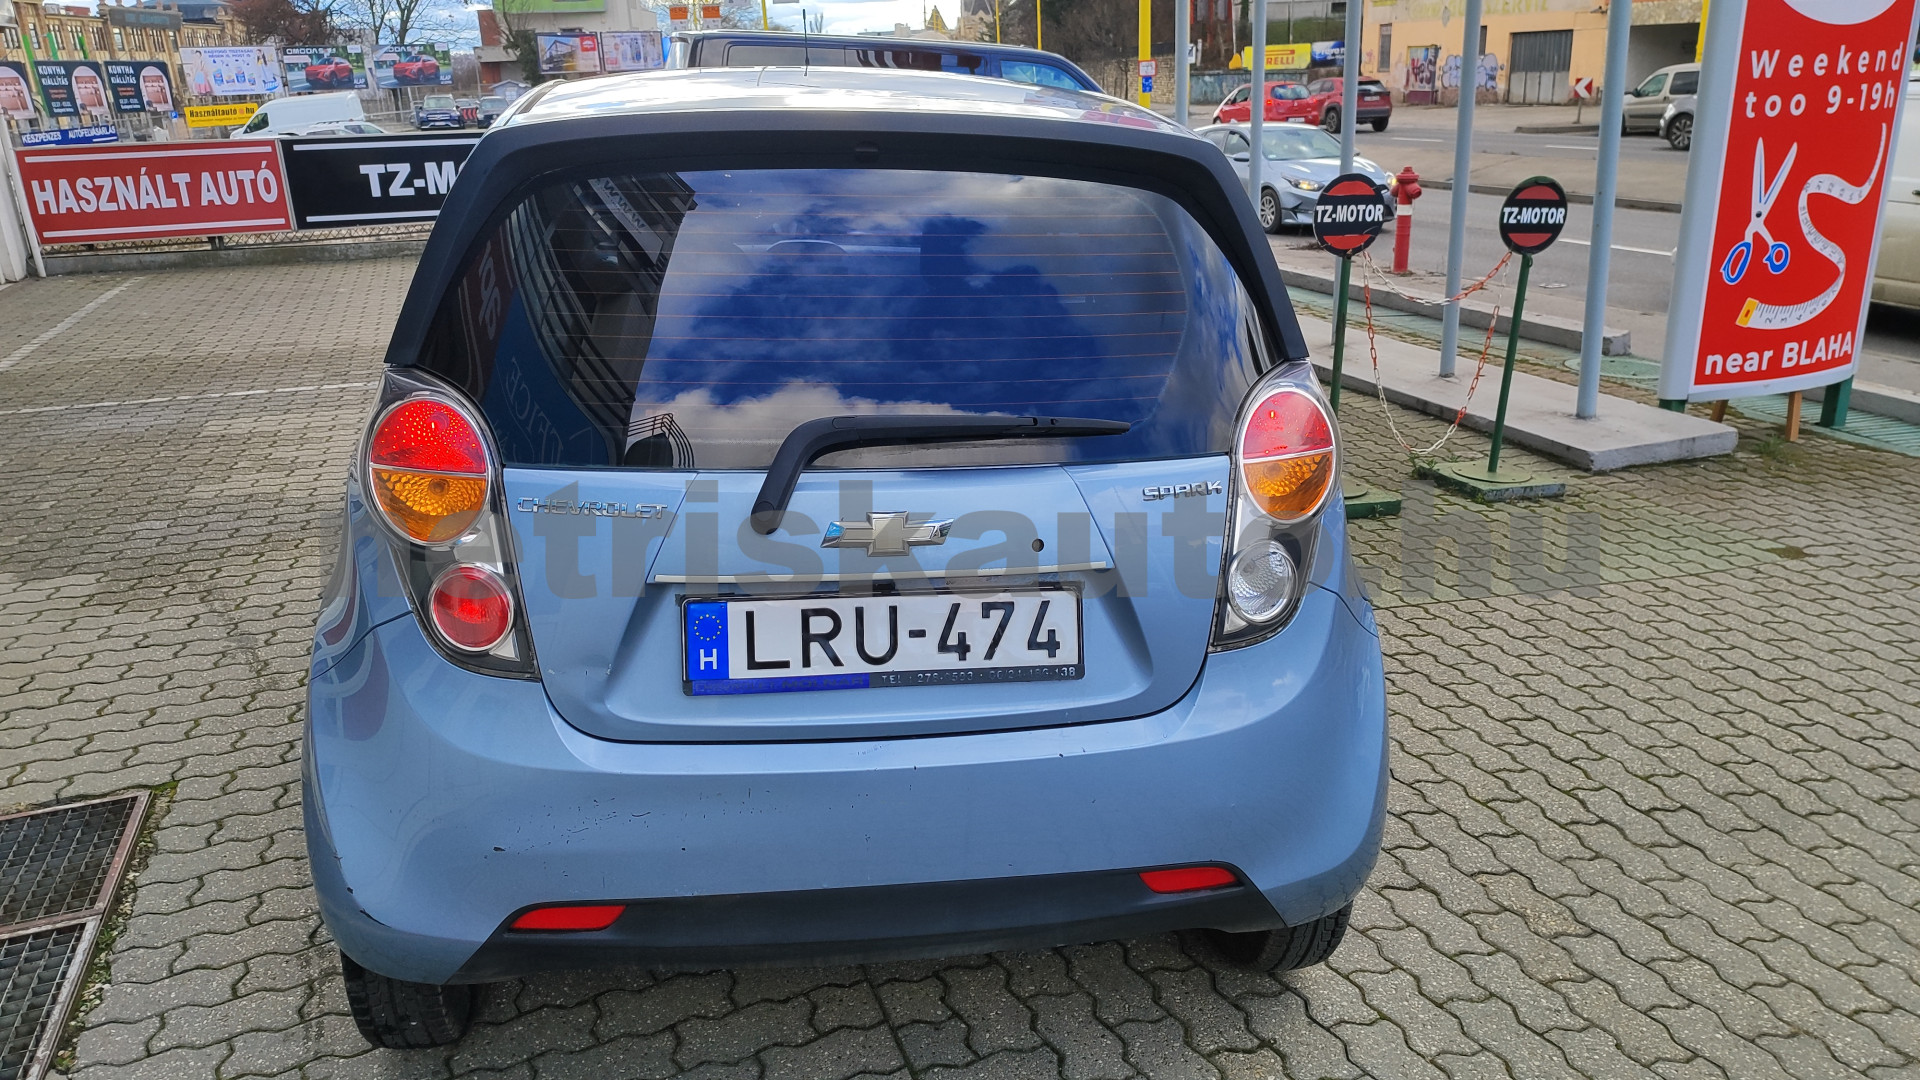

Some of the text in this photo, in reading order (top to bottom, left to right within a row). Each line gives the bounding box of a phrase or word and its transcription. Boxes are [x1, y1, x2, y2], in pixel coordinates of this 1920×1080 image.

[1266, 56, 1295, 65] RELLI
[1751, 41, 1904, 79] Weekend
[1745, 81, 1896, 119] too 9-19h
[189, 107, 237, 118] Használtautó
[30, 160, 278, 215] HASZNÁLT AUTÓ
[359, 162, 468, 197] TZ-M
[1316, 204, 1384, 224] TZ-MOTOR
[1502, 207, 1566, 225] TZ-MOTOR
[1704, 331, 1854, 376] near BLAHA
[1141, 479, 1224, 501] SPARK
[516, 496, 668, 520] CHEVROLET
[745, 600, 1061, 671] LRU-474
[699, 648, 718, 670] H
